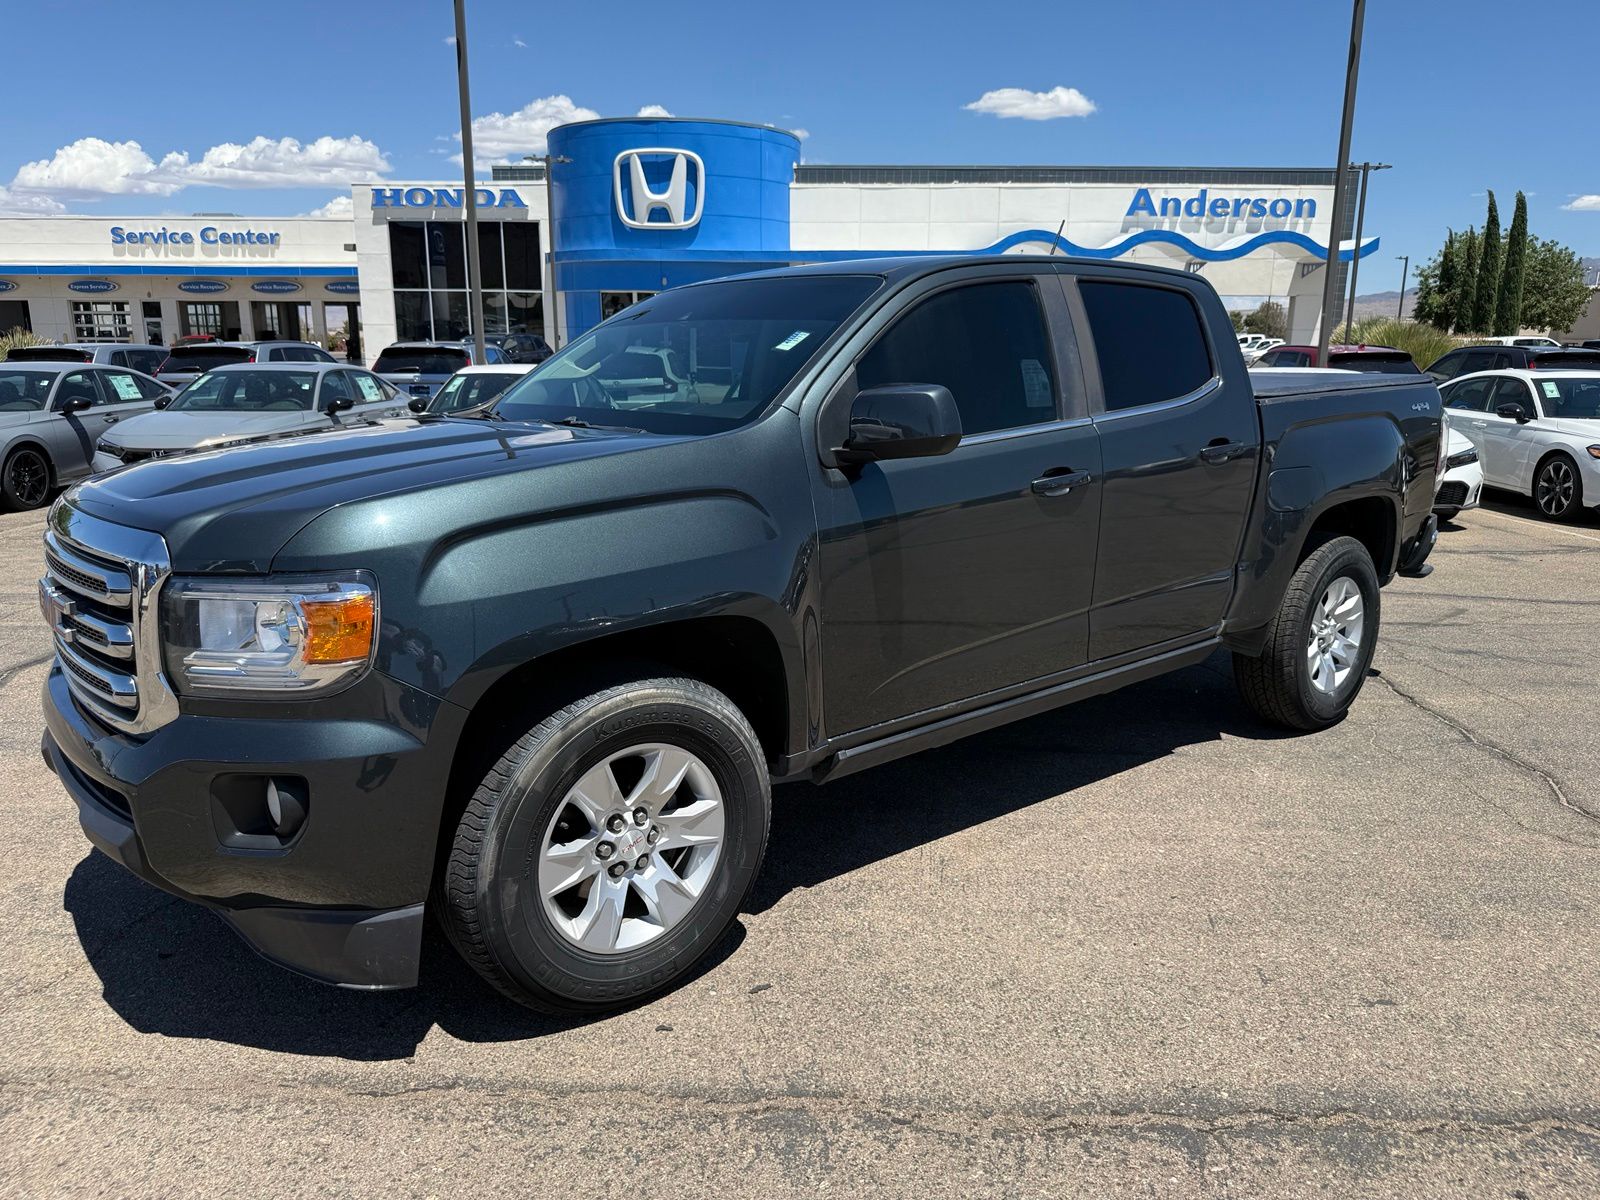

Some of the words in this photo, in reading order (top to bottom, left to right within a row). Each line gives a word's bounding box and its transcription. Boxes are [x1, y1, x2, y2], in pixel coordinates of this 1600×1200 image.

[370, 187, 529, 208] HONDA
[1125, 187, 1317, 218] Anderson
[110, 226, 195, 245] Service
[199, 226, 280, 245] Center
[200, 283, 226, 291] Reception
[621, 835, 644, 855] GMC
